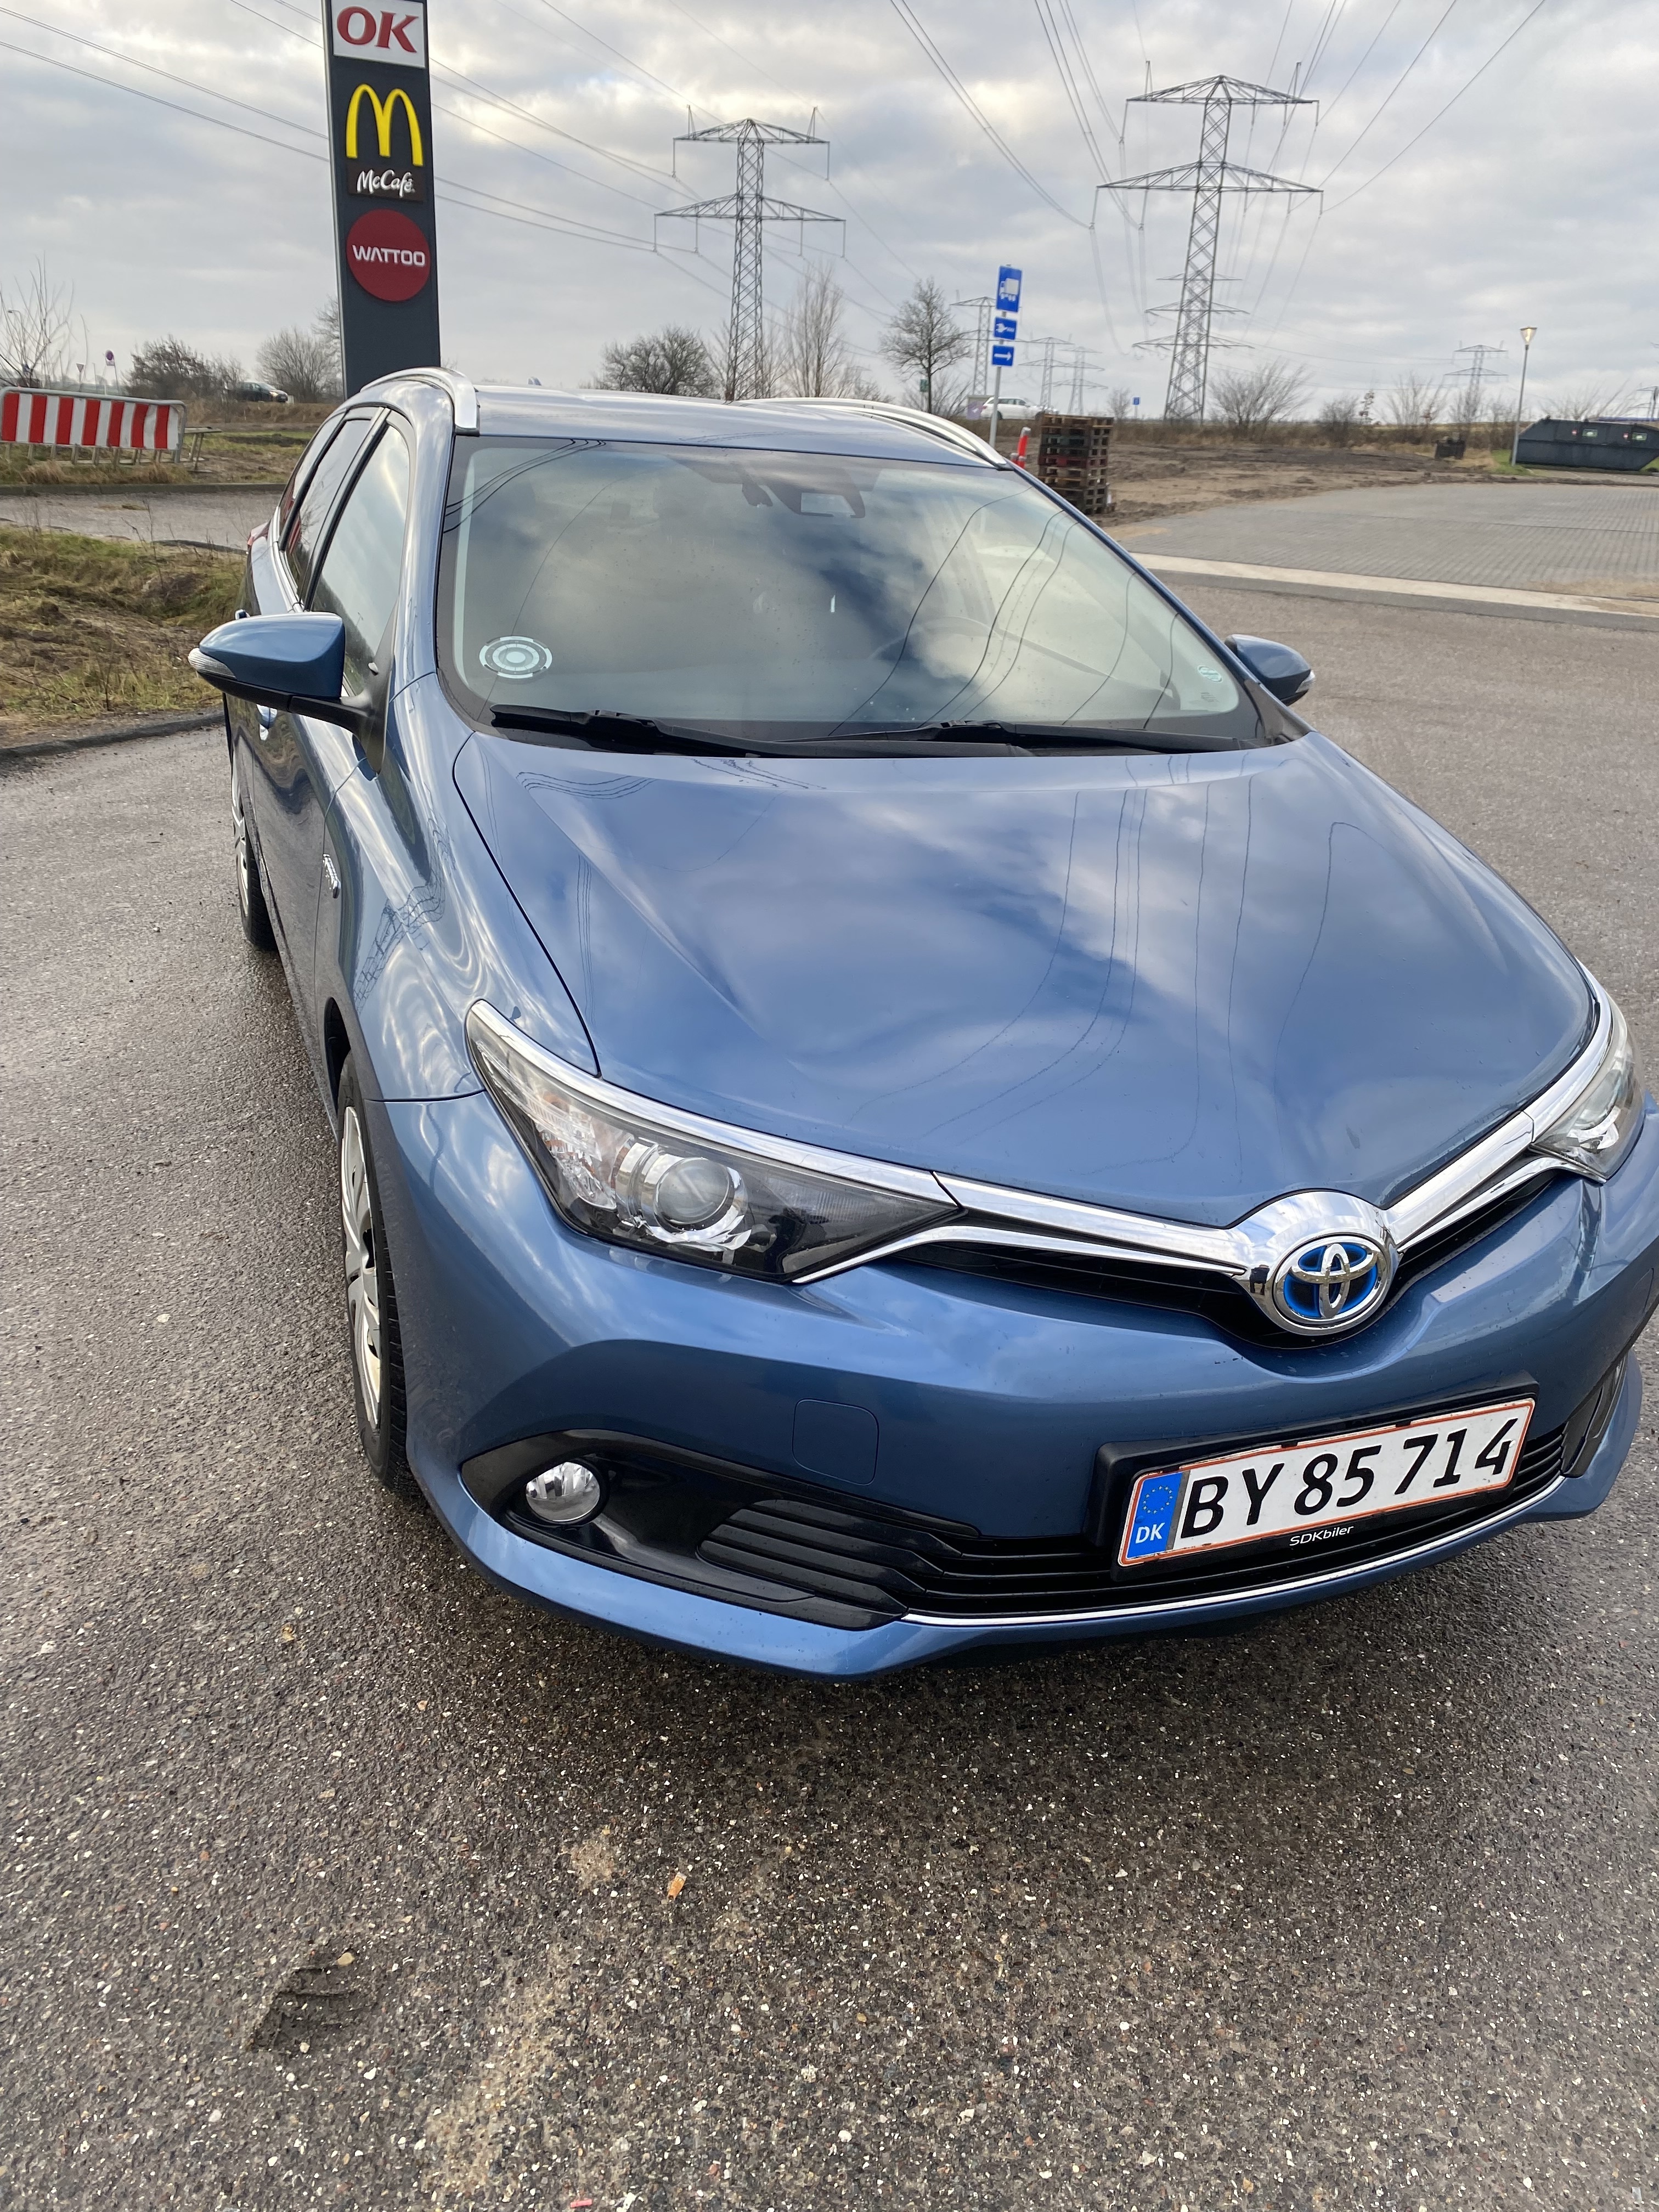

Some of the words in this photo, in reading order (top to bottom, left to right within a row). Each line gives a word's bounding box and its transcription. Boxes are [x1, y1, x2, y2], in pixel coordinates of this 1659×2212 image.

[336, 5, 419, 53] OK
[357, 169, 413, 198] McCafé
[352, 244, 426, 267] WATTOO
[1181, 1463, 1285, 1539] BY
[1294, 1444, 1382, 1515] 85
[1394, 1418, 1519, 1495] 714
[1135, 1522, 1165, 1544] DK
[1289, 1526, 1355, 1546] SDKbiler
